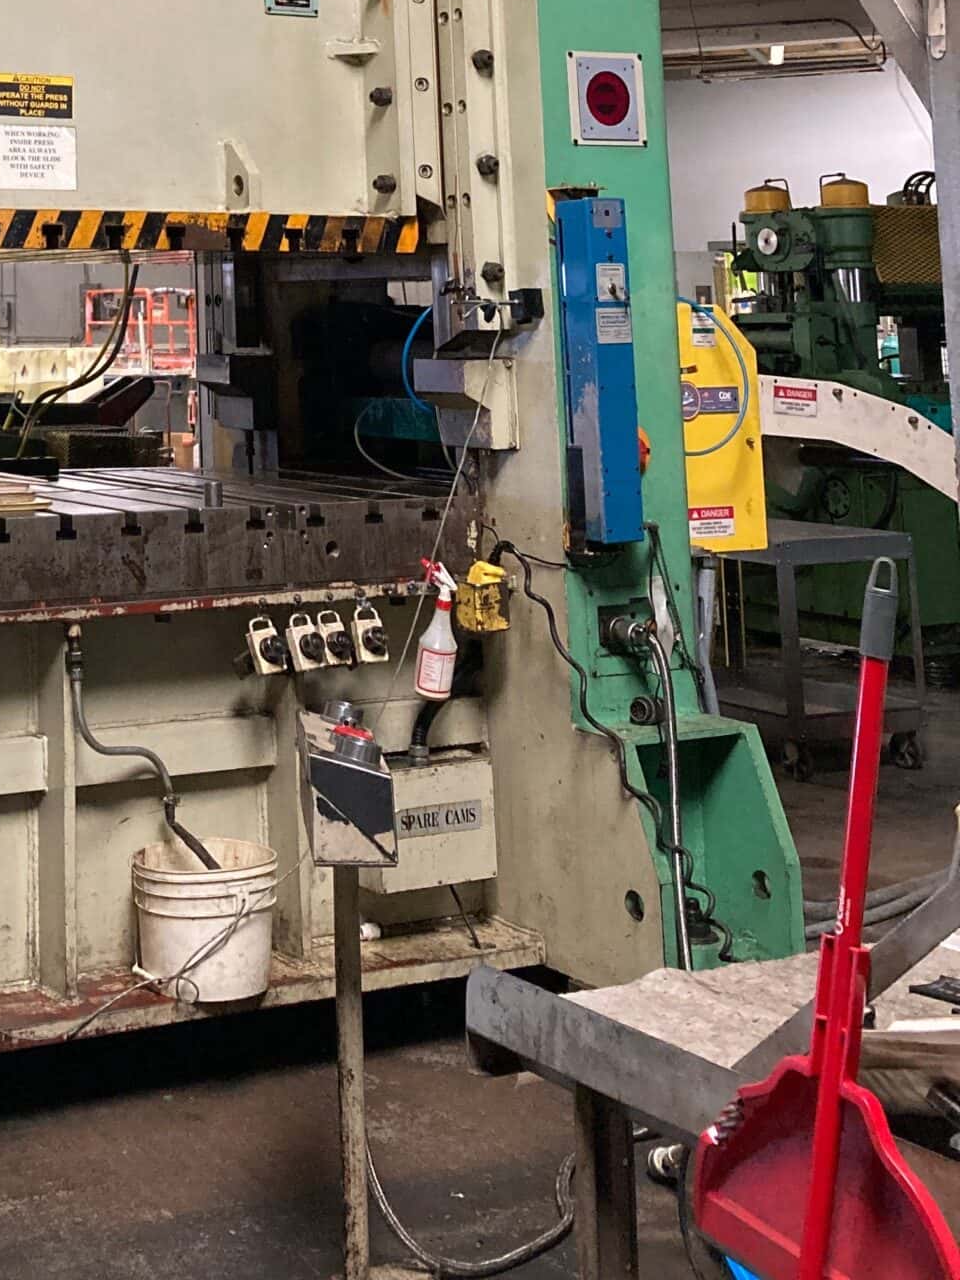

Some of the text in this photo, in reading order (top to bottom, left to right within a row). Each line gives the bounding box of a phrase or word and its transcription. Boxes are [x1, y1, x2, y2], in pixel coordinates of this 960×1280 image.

[19, 74, 51, 84] CAUTION
[19, 84, 46, 94] DO NOT
[30, 93, 44, 101] THE
[45, 94, 68, 102] PRESS
[29, 101, 59, 110] GUARDS
[59, 102, 68, 110] IN
[786, 388, 813, 399] DANGER
[700, 508, 730, 518] DANGER
[400, 807, 476, 831] SPARE CAMS
